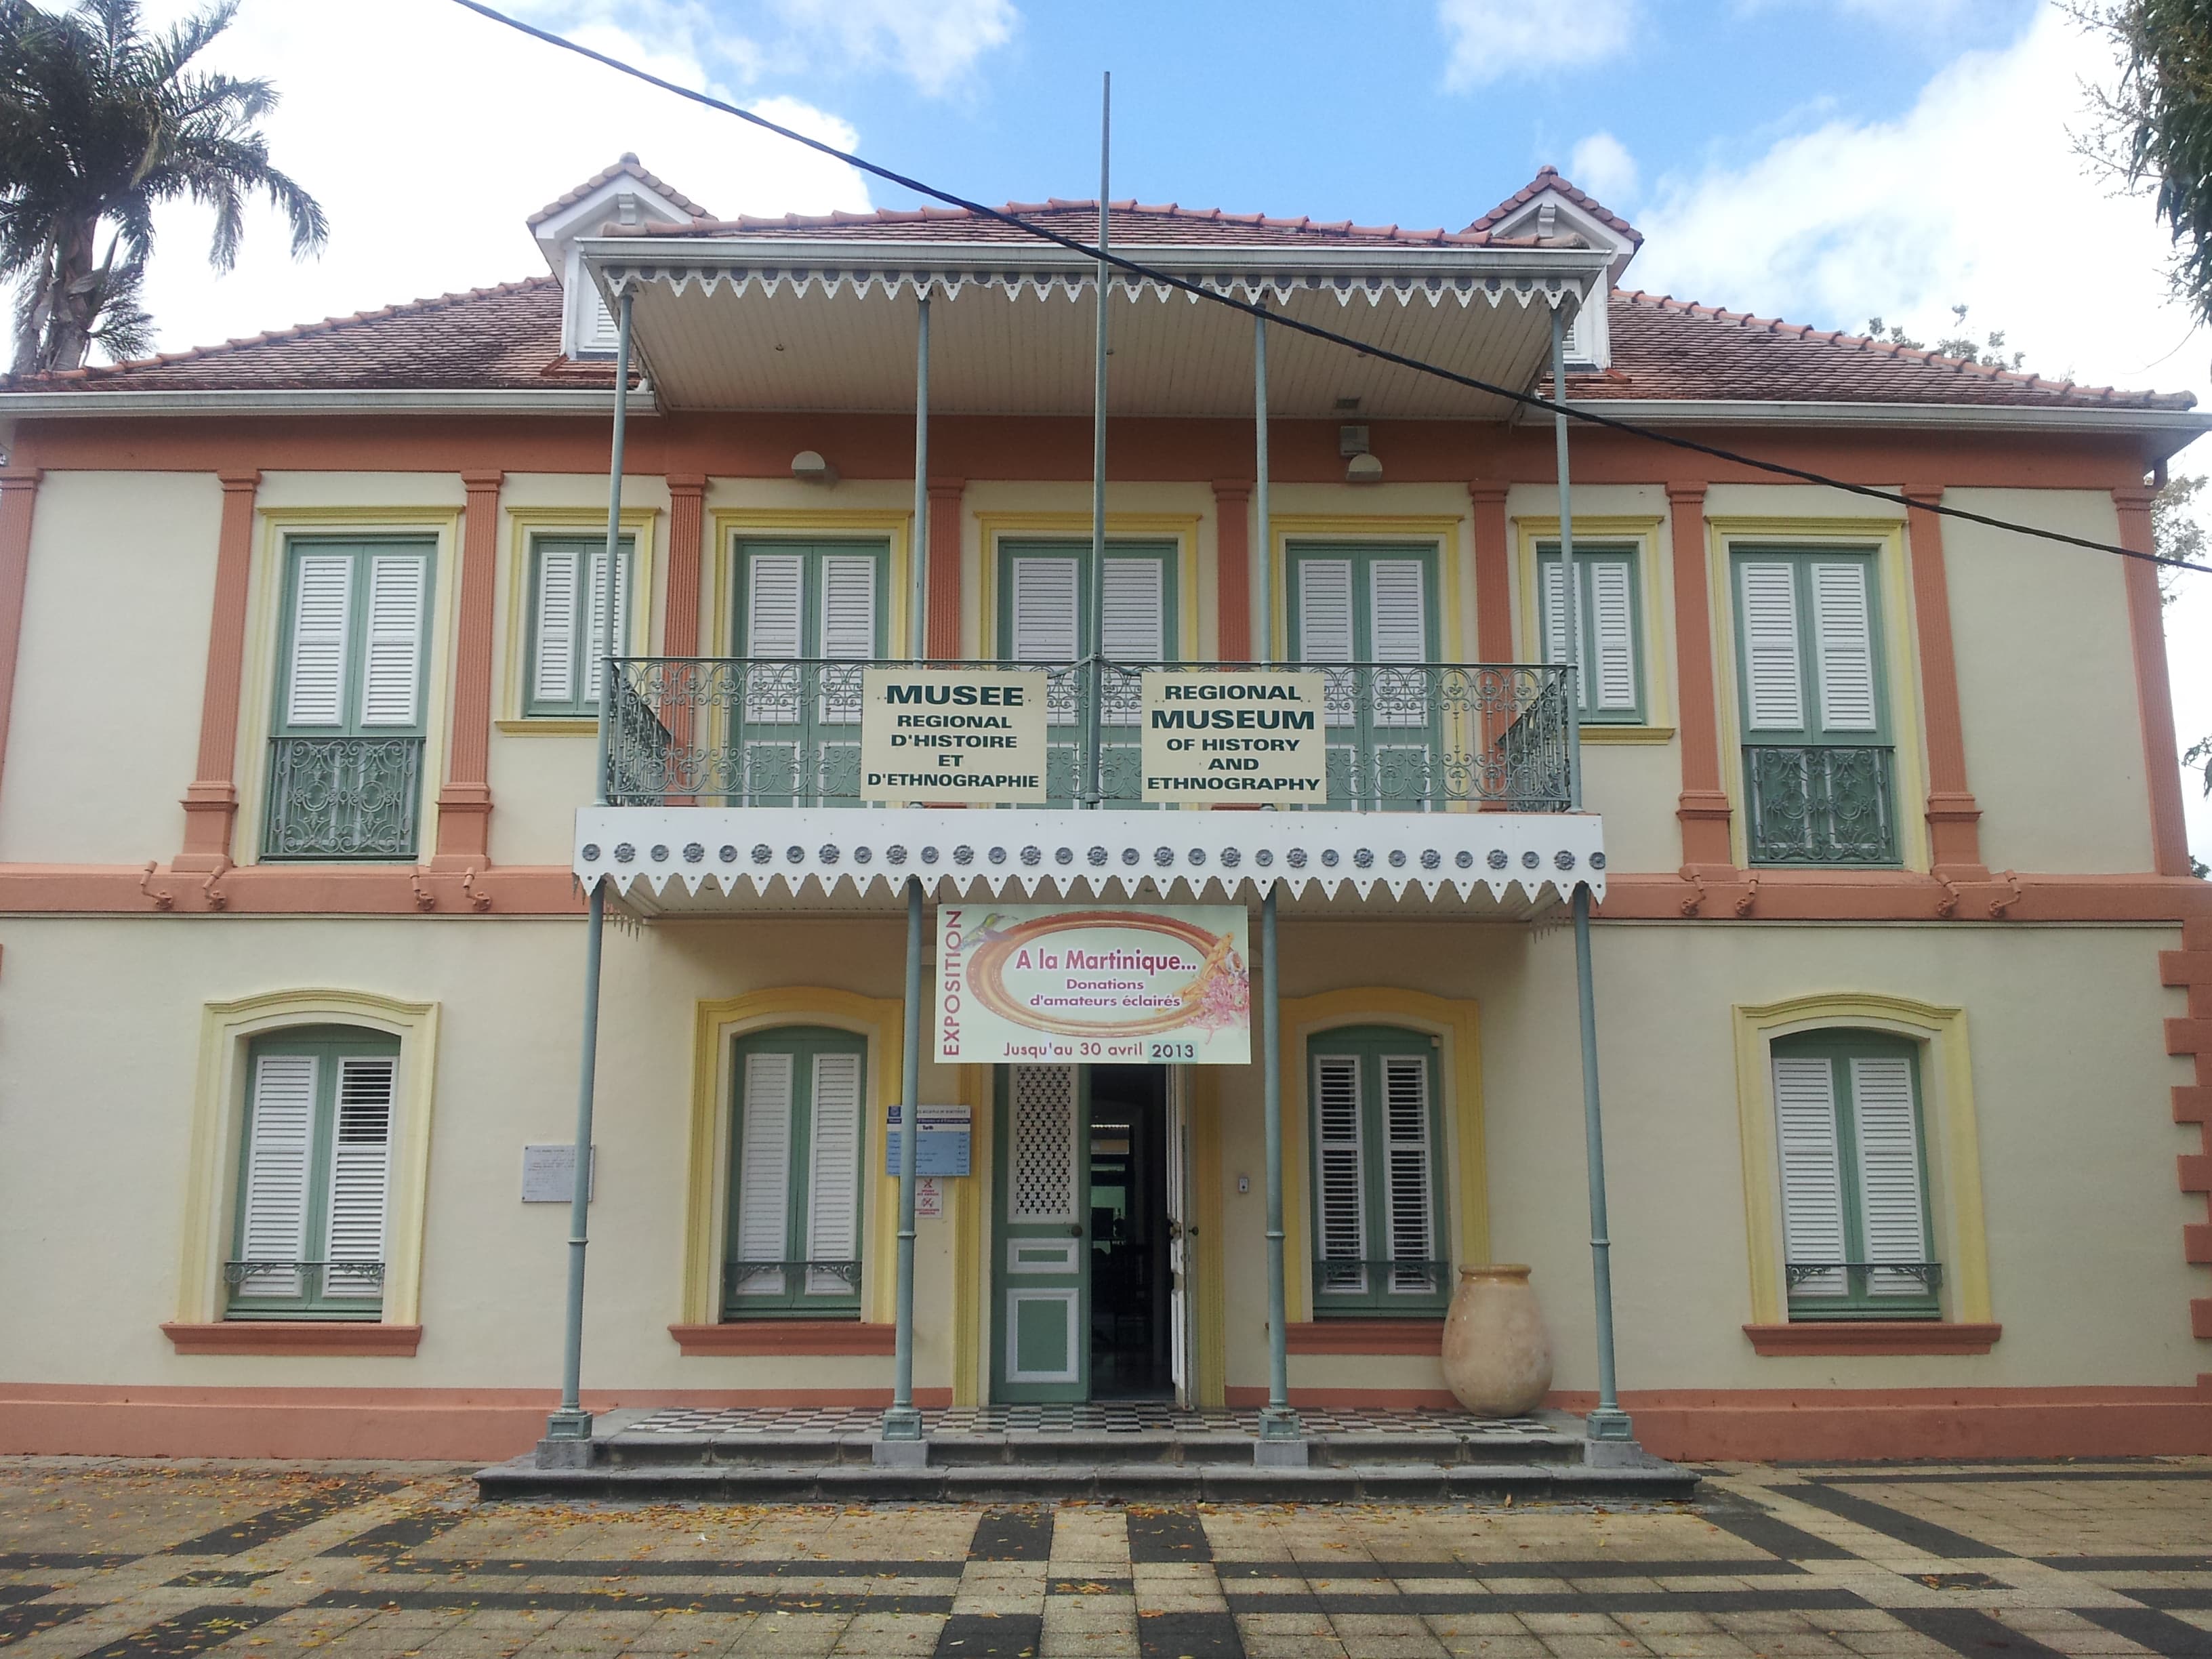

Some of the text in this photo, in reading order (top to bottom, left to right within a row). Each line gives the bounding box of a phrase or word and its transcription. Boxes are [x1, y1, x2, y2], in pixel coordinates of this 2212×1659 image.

[886, 685, 1023, 706] MUSEE
[1165, 685, 1300, 700] REGIONAL
[897, 715, 1012, 729] REGIONAL
[1152, 710, 1314, 730] MUSEUM
[891, 734, 1017, 748] D'HISTOIRE
[1166, 739, 1300, 752] OF HISTORY
[939, 754, 964, 766] ET
[1208, 758, 1259, 771] AND
[867, 773, 1039, 787] D'ETHNOGRAPHIE
[1147, 777, 1320, 791] ETHNOGRAPHY
[1015, 949, 1197, 976] A la Martinique...
[943, 910, 962, 1056] EXPOSITION
[1066, 979, 1145, 990] Donations
[1030, 994, 1181, 1007] d'amateurs éclairés
[1003, 1042, 1195, 1059] Jusqu'au 30 avril 2013
